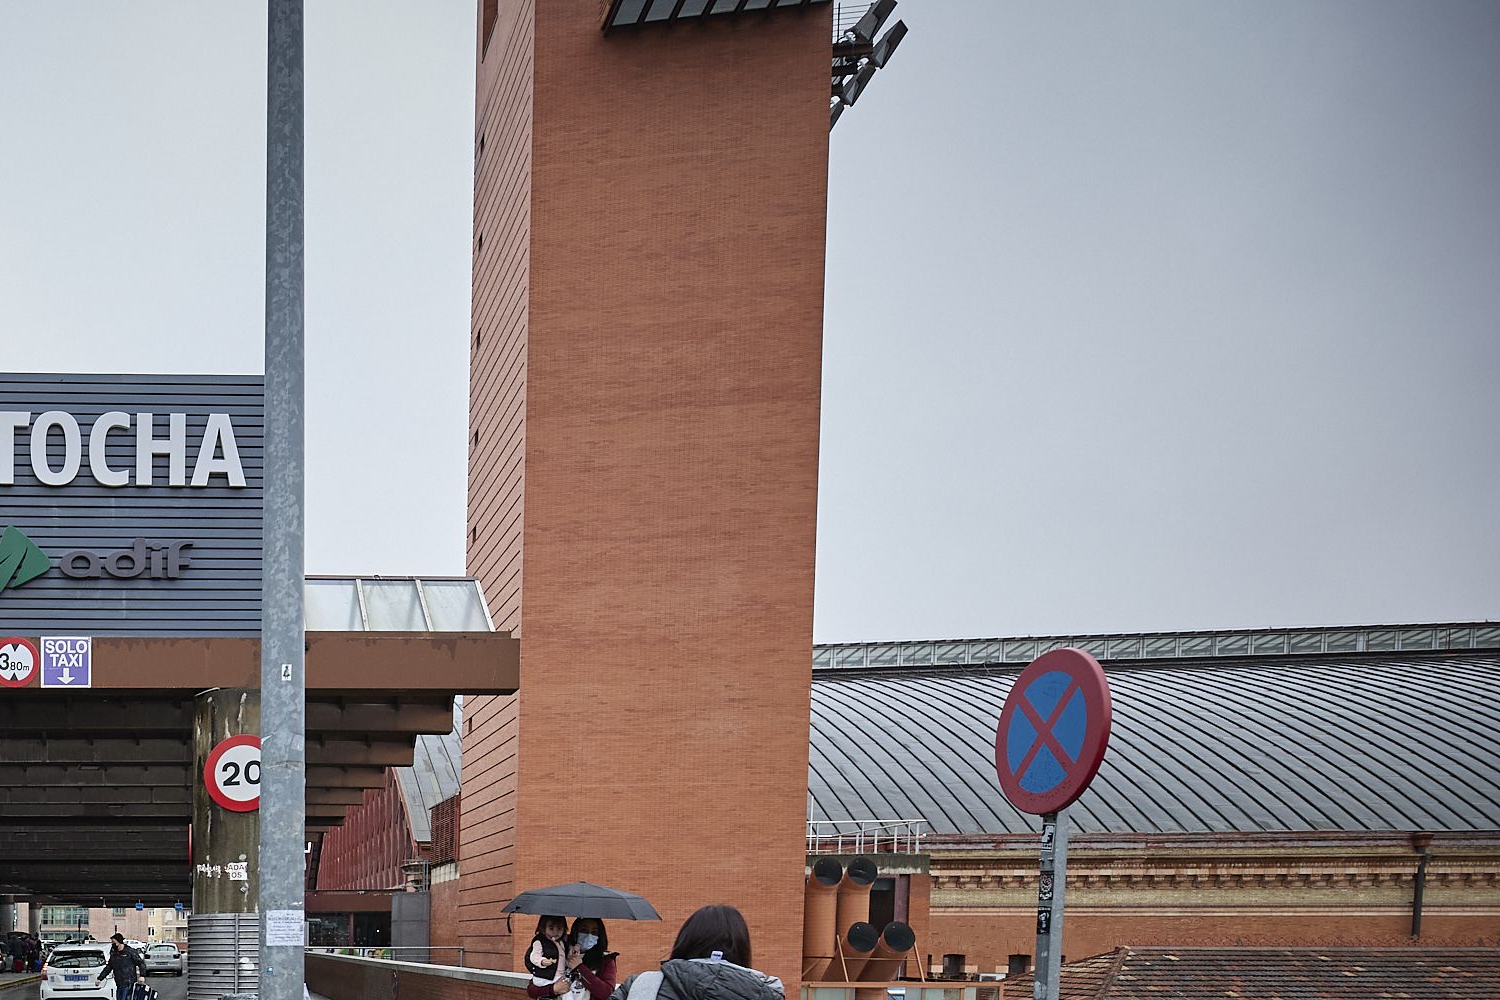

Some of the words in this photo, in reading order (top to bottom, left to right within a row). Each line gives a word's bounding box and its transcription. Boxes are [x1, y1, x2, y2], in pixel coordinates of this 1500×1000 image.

[59, 537, 197, 579] adif
[45, 640, 88, 654] SOLO
[49, 653, 83, 667] TAXI
[221, 760, 261, 787] 20
